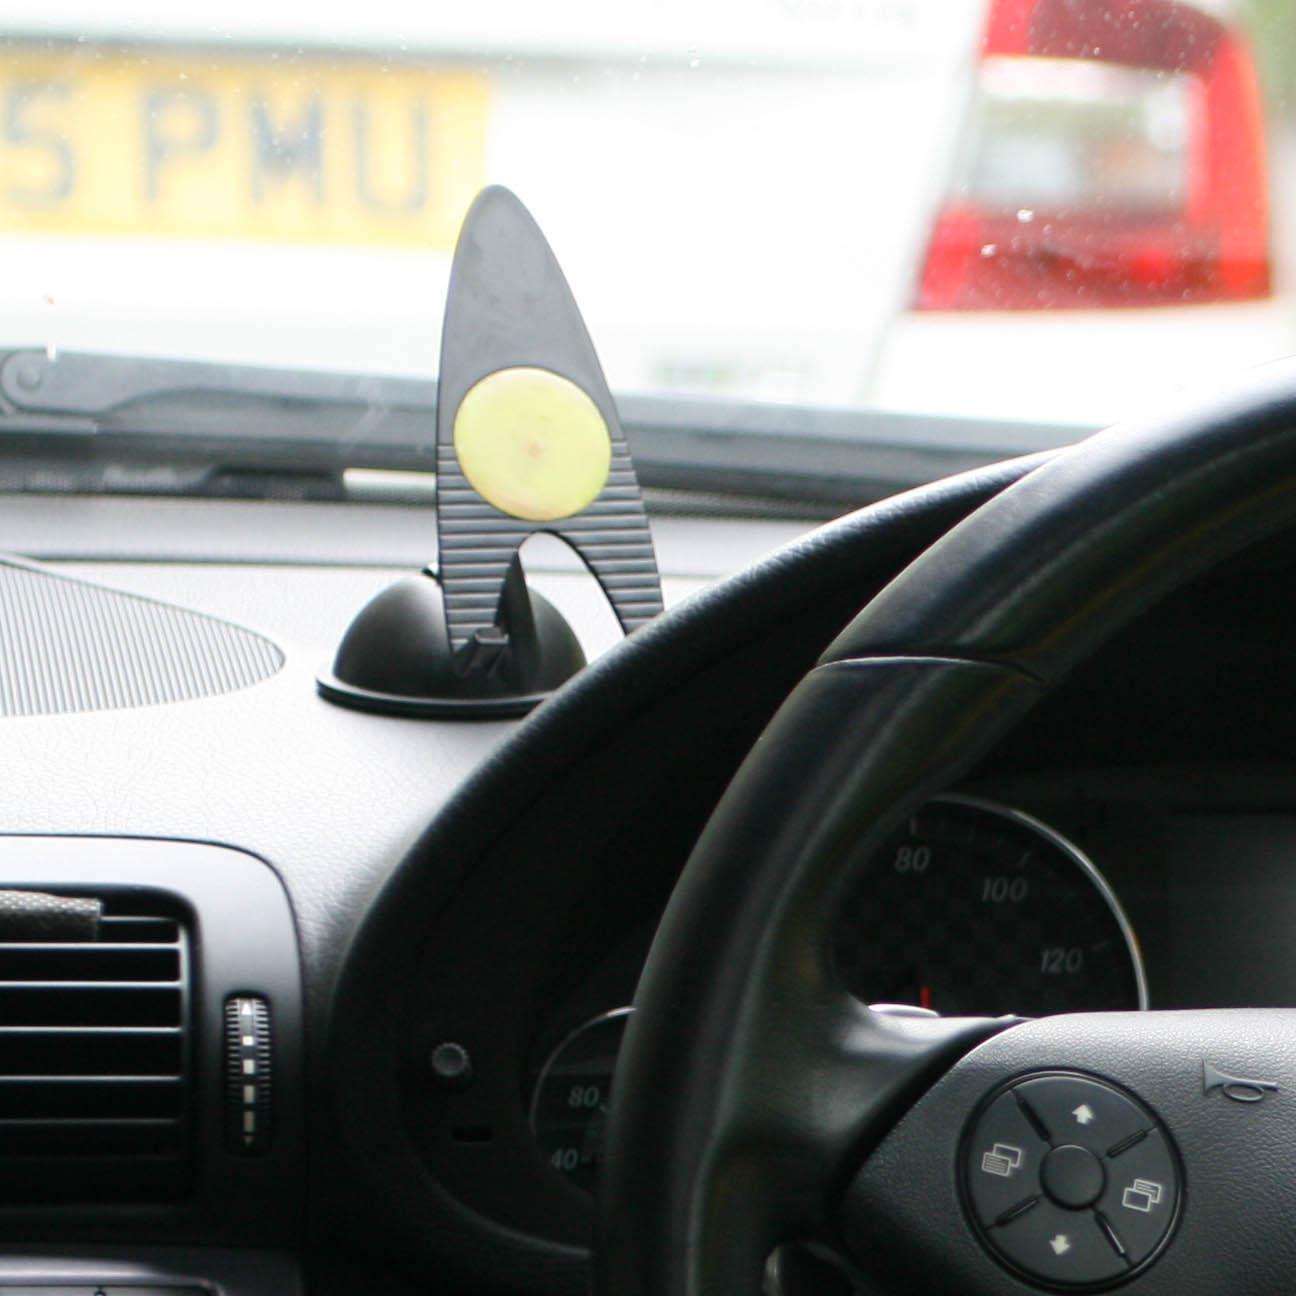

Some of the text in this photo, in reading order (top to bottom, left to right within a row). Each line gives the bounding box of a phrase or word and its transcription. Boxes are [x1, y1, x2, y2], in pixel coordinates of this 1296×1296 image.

[141, 82, 430, 212] PMU
[893, 845, 932, 874] 80
[981, 876, 1028, 904] 100
[1037, 947, 1083, 976] 120
[567, 1085, 600, 1108] 80
